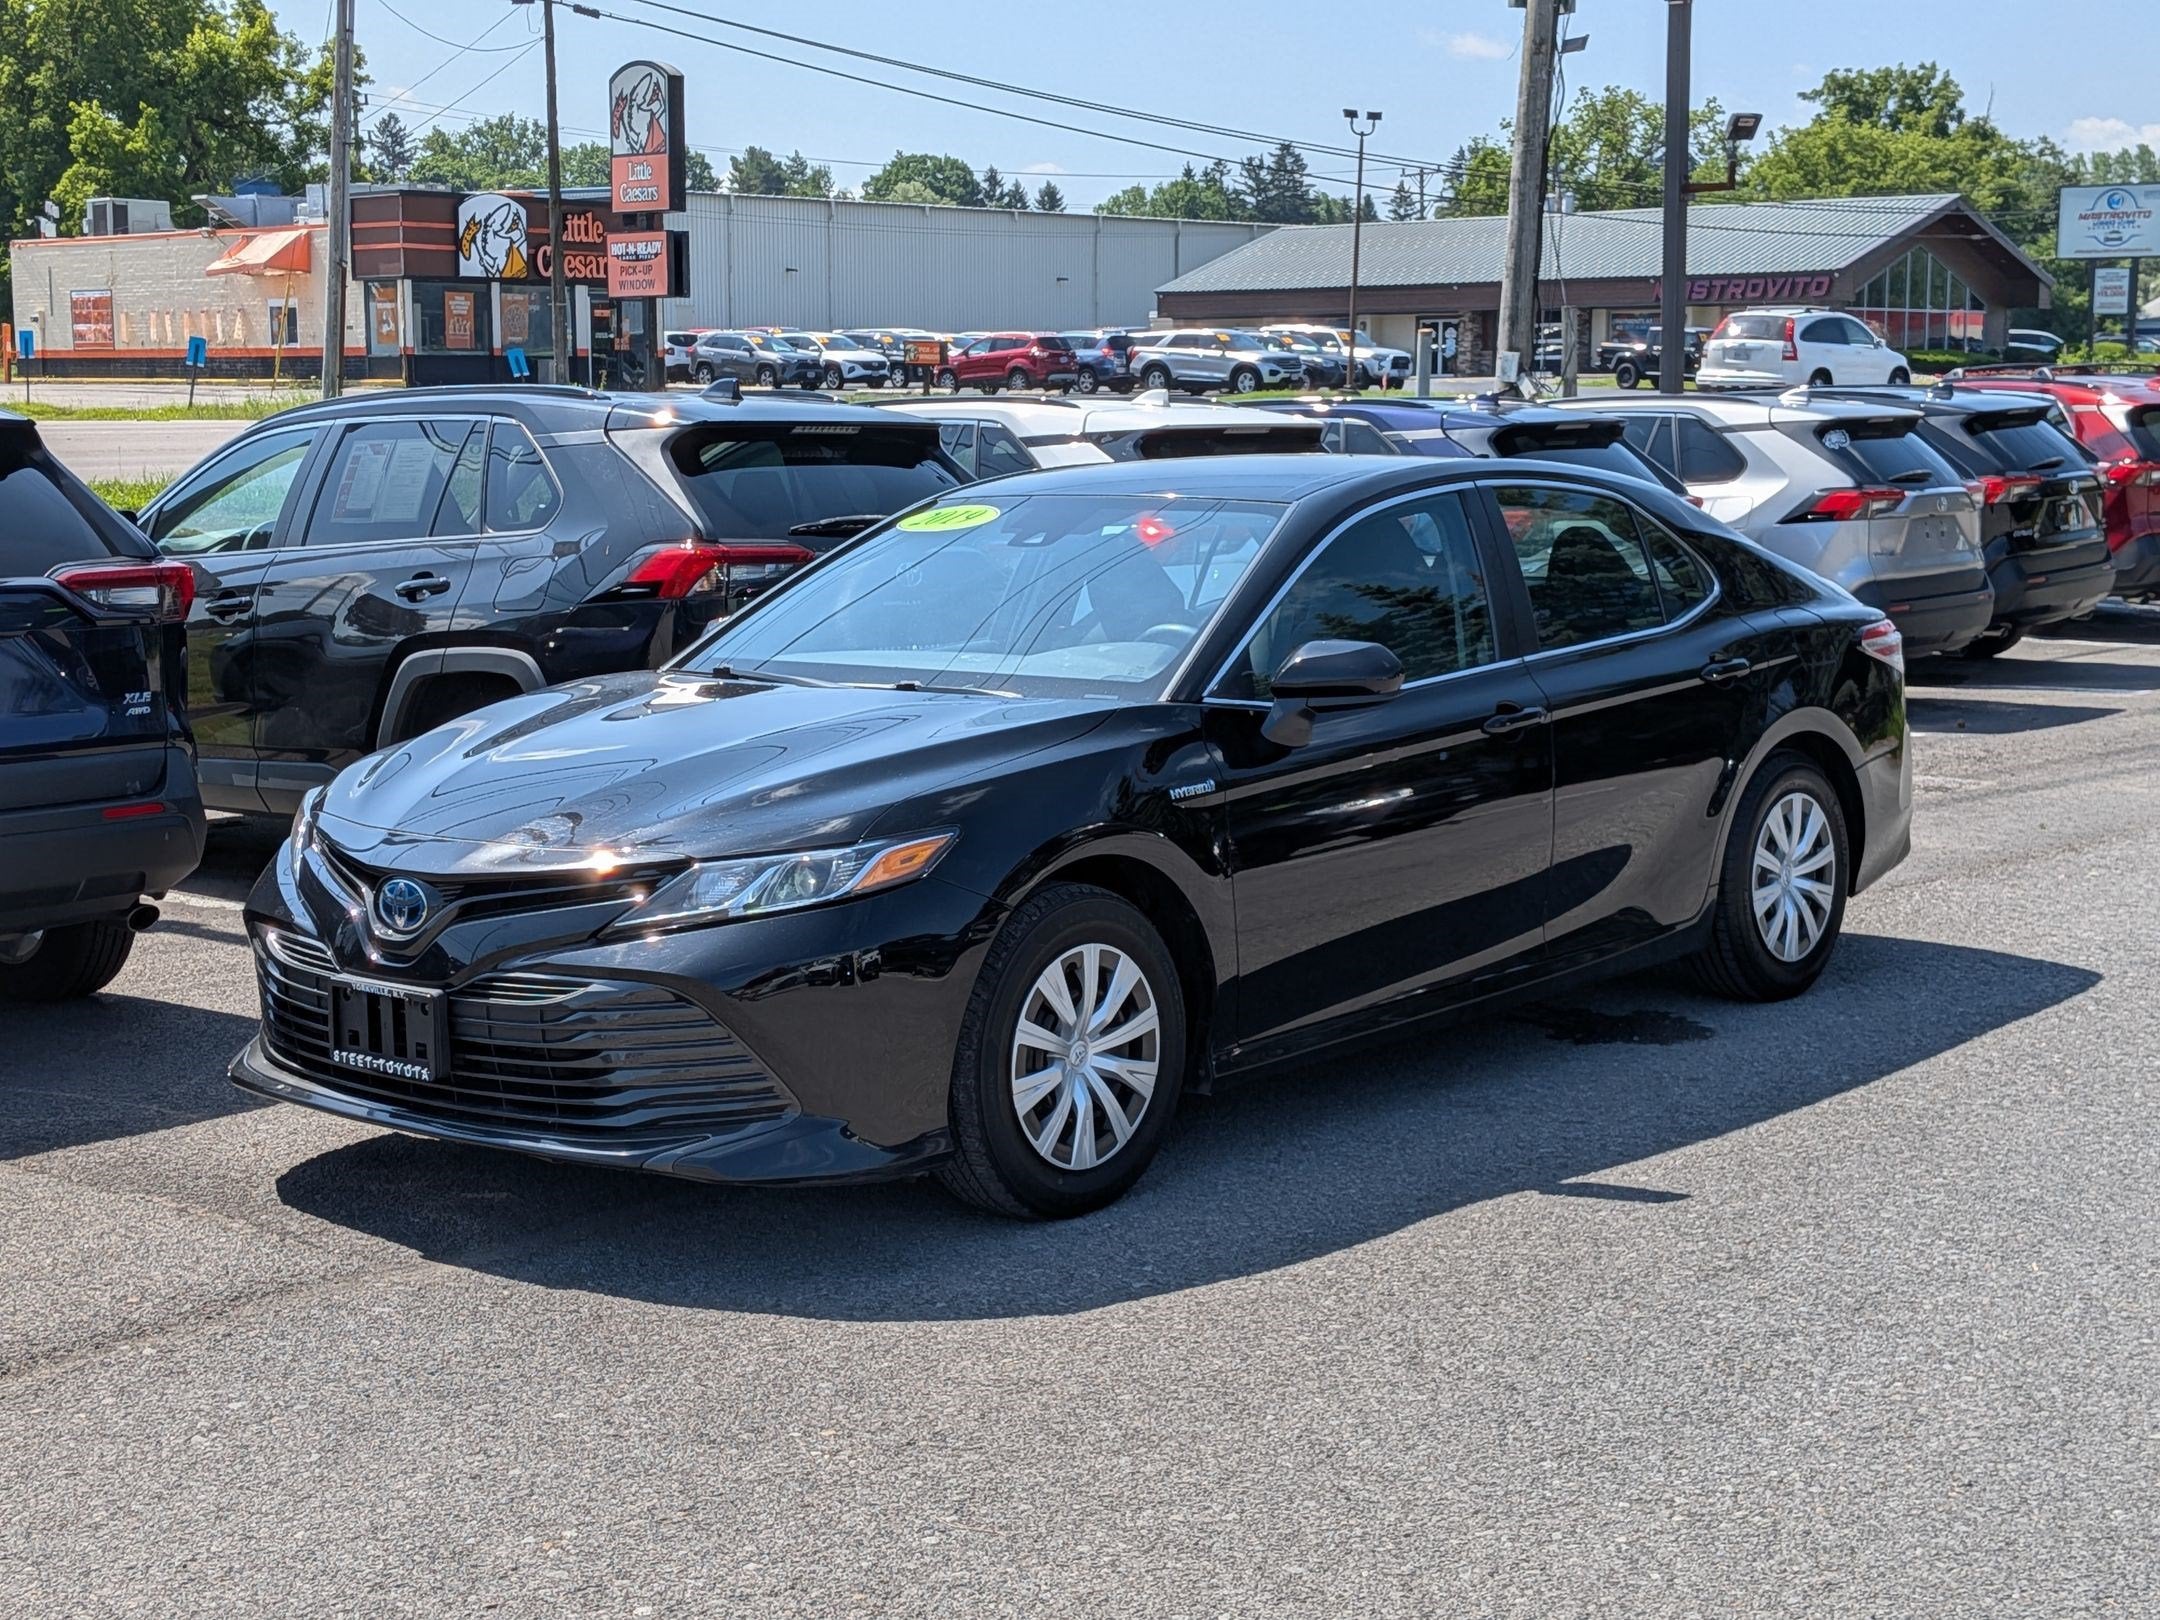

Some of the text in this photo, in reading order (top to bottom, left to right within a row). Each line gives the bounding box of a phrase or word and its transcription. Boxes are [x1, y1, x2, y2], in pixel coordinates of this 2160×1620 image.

[628, 161, 652, 180] Little
[620, 183, 658, 203] Caesars
[562, 212, 604, 243] ittle
[611, 241, 662, 256] HOT-N-READY
[537, 244, 608, 278] Cesar
[620, 264, 653, 277] PICK-UP
[619, 279, 656, 291] WINDOW
[123, 691, 151, 704] XLE
[125, 706, 151, 716] AWD
[1169, 781, 1209, 800] HYBRID
